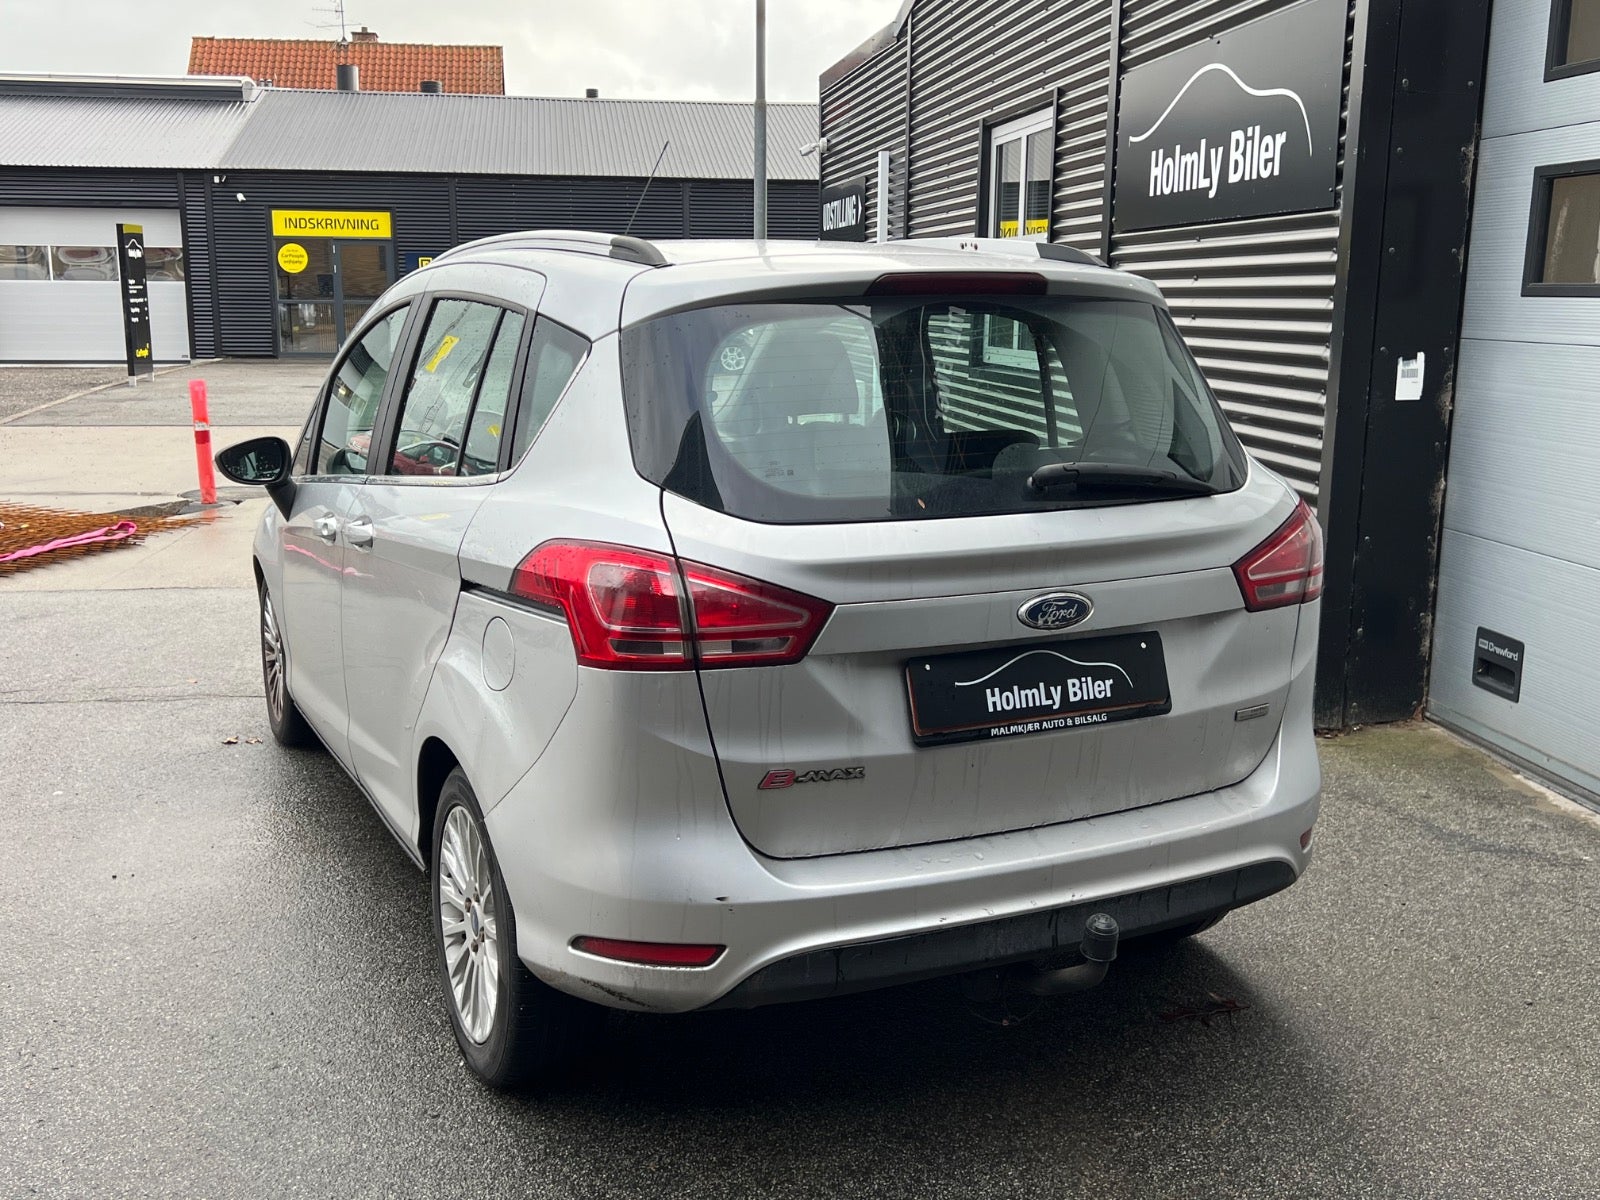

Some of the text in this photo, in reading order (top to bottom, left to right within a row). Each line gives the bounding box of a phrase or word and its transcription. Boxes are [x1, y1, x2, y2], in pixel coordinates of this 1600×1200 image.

[1149, 125, 1287, 199] HolmLy Biler
[284, 217, 380, 231] INDSKRIVNING
[823, 195, 856, 231] UDSTILLING
[1038, 599, 1078, 620] Ford
[985, 676, 1114, 713] HolmLy Biler
[990, 713, 1108, 736] MALMKJÆR AUTO & BILSALG
[758, 766, 865, 790] B-MAX
